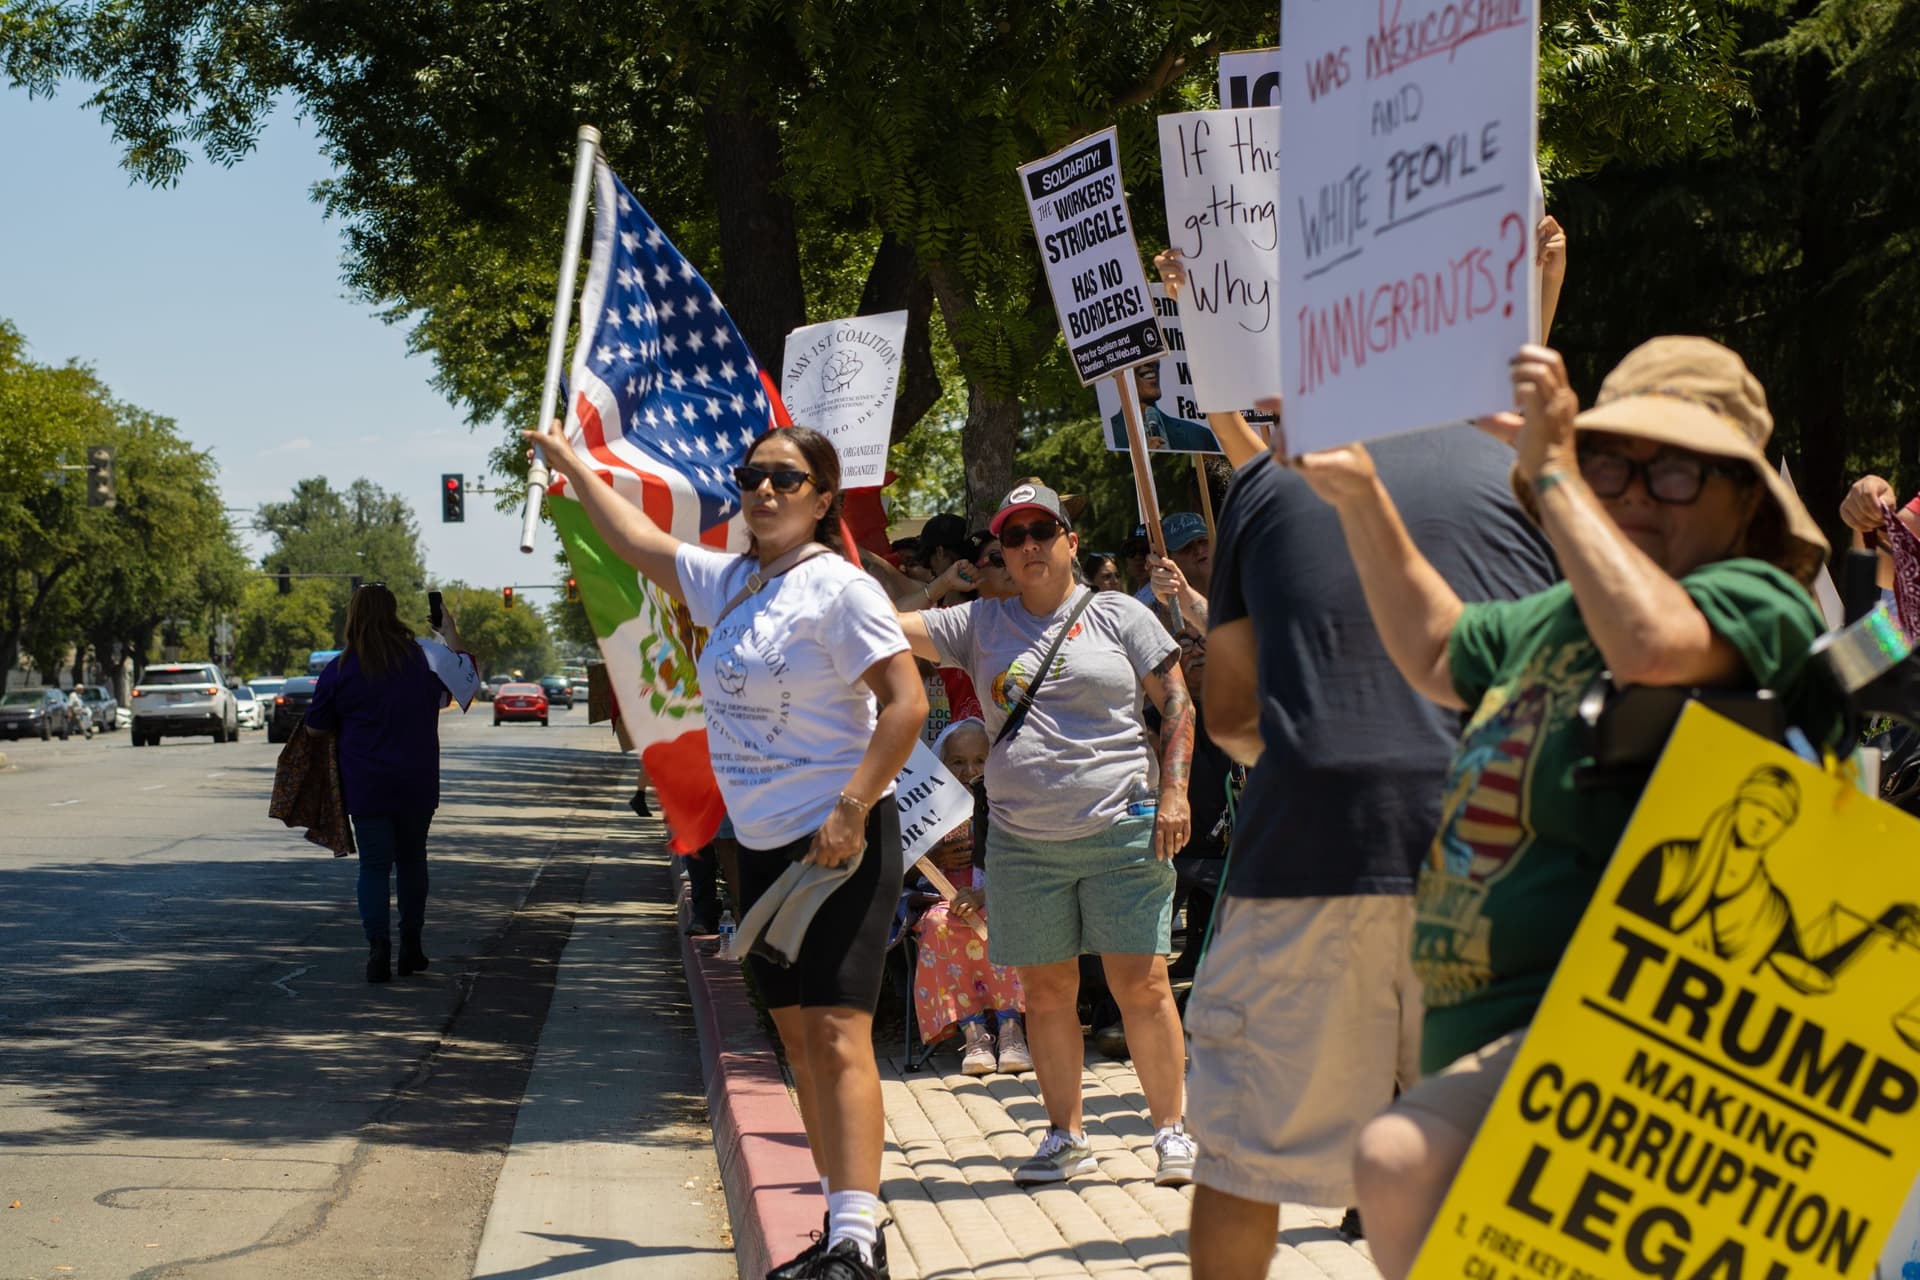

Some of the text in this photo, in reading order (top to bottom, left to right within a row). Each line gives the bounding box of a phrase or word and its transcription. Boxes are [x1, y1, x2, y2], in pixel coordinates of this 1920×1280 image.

[1306, 46, 1350, 103] WAS
[1371, 83, 1422, 136] AND
[1042, 149, 1102, 192] SOLDARITY!
[1178, 119, 1210, 178] If
[1298, 121, 1501, 260] WHITE PEOPLE
[1044, 204, 1127, 265] STRUGGLE
[1180, 184, 1278, 259] getting
[1072, 258, 1123, 303] HAS NO
[1188, 259, 1271, 333] Why
[1068, 286, 1145, 340] BORDERS!
[1118, 333, 1131, 346] and
[786, 353, 812, 383] MAY
[811, 334, 833, 357] 1ST
[874, 376, 895, 409] MAYO
[1606, 925, 1920, 1126] TRUMP
[1624, 1049, 1818, 1171] MAKING
[1519, 1062, 1871, 1276] CORRUPTION
